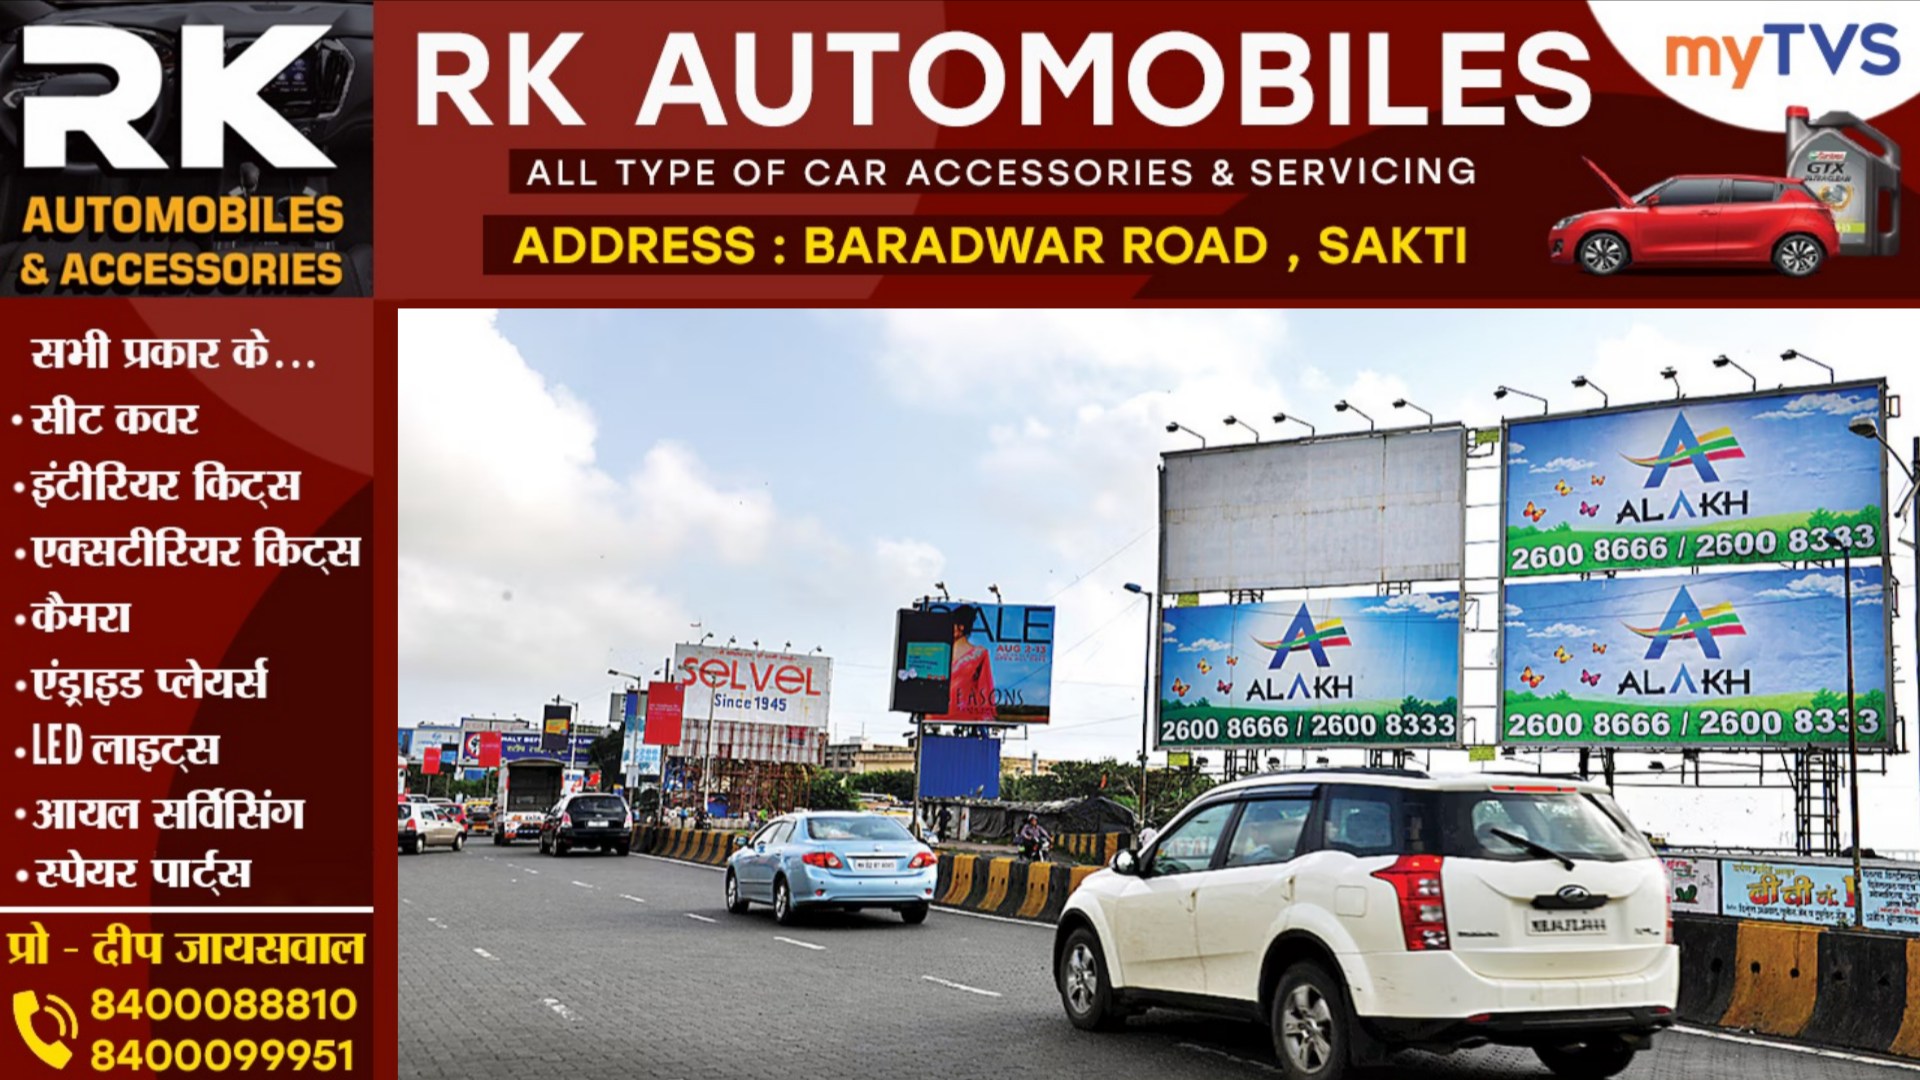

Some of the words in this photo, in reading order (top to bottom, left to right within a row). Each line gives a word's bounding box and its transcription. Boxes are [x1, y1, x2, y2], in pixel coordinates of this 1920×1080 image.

[1666, 23, 1901, 89] myTVS
[24, 25, 337, 169] RK
[418, 33, 586, 126] RK
[636, 31, 1592, 128] AUTOMOBILES
[527, 160, 596, 185] ALL
[616, 160, 714, 185] TYPE
[734, 160, 784, 185] OF
[805, 160, 886, 185] CAR
[906, 160, 1191, 186] ACCESSORIES
[1211, 160, 1234, 186] &
[1251, 159, 1475, 185] SERVICING
[1807, 162, 1845, 174] GTX
[23, 197, 343, 233] AUTOMOBILES
[513, 227, 754, 264] ADDRESS
[805, 227, 1104, 263] BARADWAR
[1124, 227, 1267, 264] ROAD
[1318, 227, 1466, 264] SAKTI
[22, 253, 49, 285] &
[61, 253, 342, 286] ACCESSORIES
[31, 329, 111, 369] सभी
[122, 339, 220, 369] प्रकार
[31, 395, 104, 435] सीट
[115, 405, 199, 435] कवर
[31, 461, 180, 508] इंटीरियर
[193, 461, 301, 509] किट्स
[1616, 490, 1748, 524] ALAKH
[30, 527, 241, 568] एक्सटीरियर
[253, 527, 361, 575] किट्स
[1511, 542, 1584, 571] 2600
[1593, 537, 1668, 561] 8666
[1677, 535, 1686, 560] /
[1696, 531, 1777, 558] 2600
[1789, 523, 1876, 553] 8333
[30, 592, 131, 632] कैमरा
[928, 606, 1052, 644] ALE
[30, 659, 144, 707] एंड्राइड
[155, 658, 268, 699] प्लेयर्स
[956, 687, 1024, 706] EASONS
[1246, 673, 1353, 701] ALAKH
[1618, 663, 1751, 695] ALAKH
[714, 692, 751, 709] Since
[755, 696, 787, 711] 1945
[1161, 718, 1219, 741] 2600
[1227, 716, 1289, 738] 8666
[1296, 714, 1303, 737] /
[1311, 714, 1377, 737] 2600
[1385, 713, 1456, 737] 8333
[1508, 712, 1583, 736] 2600
[1593, 711, 1671, 736] 8666
[1681, 711, 1689, 736] /
[1699, 709, 1783, 736] 2600
[32, 723, 83, 765] LED
[91, 735, 220, 773] लाइट्स
[33, 800, 140, 830] आयल
[152, 788, 305, 830] सर्विसिंग
[35, 850, 138, 888] स्पेयर
[151, 850, 252, 896] पार्ट्स
[7, 922, 50, 965] प्रो
[92, 923, 164, 967] दीप
[175, 934, 367, 965] जायसवाल
[91, 988, 357, 1020] 8400088810
[91, 1039, 353, 1071] 8400099951
